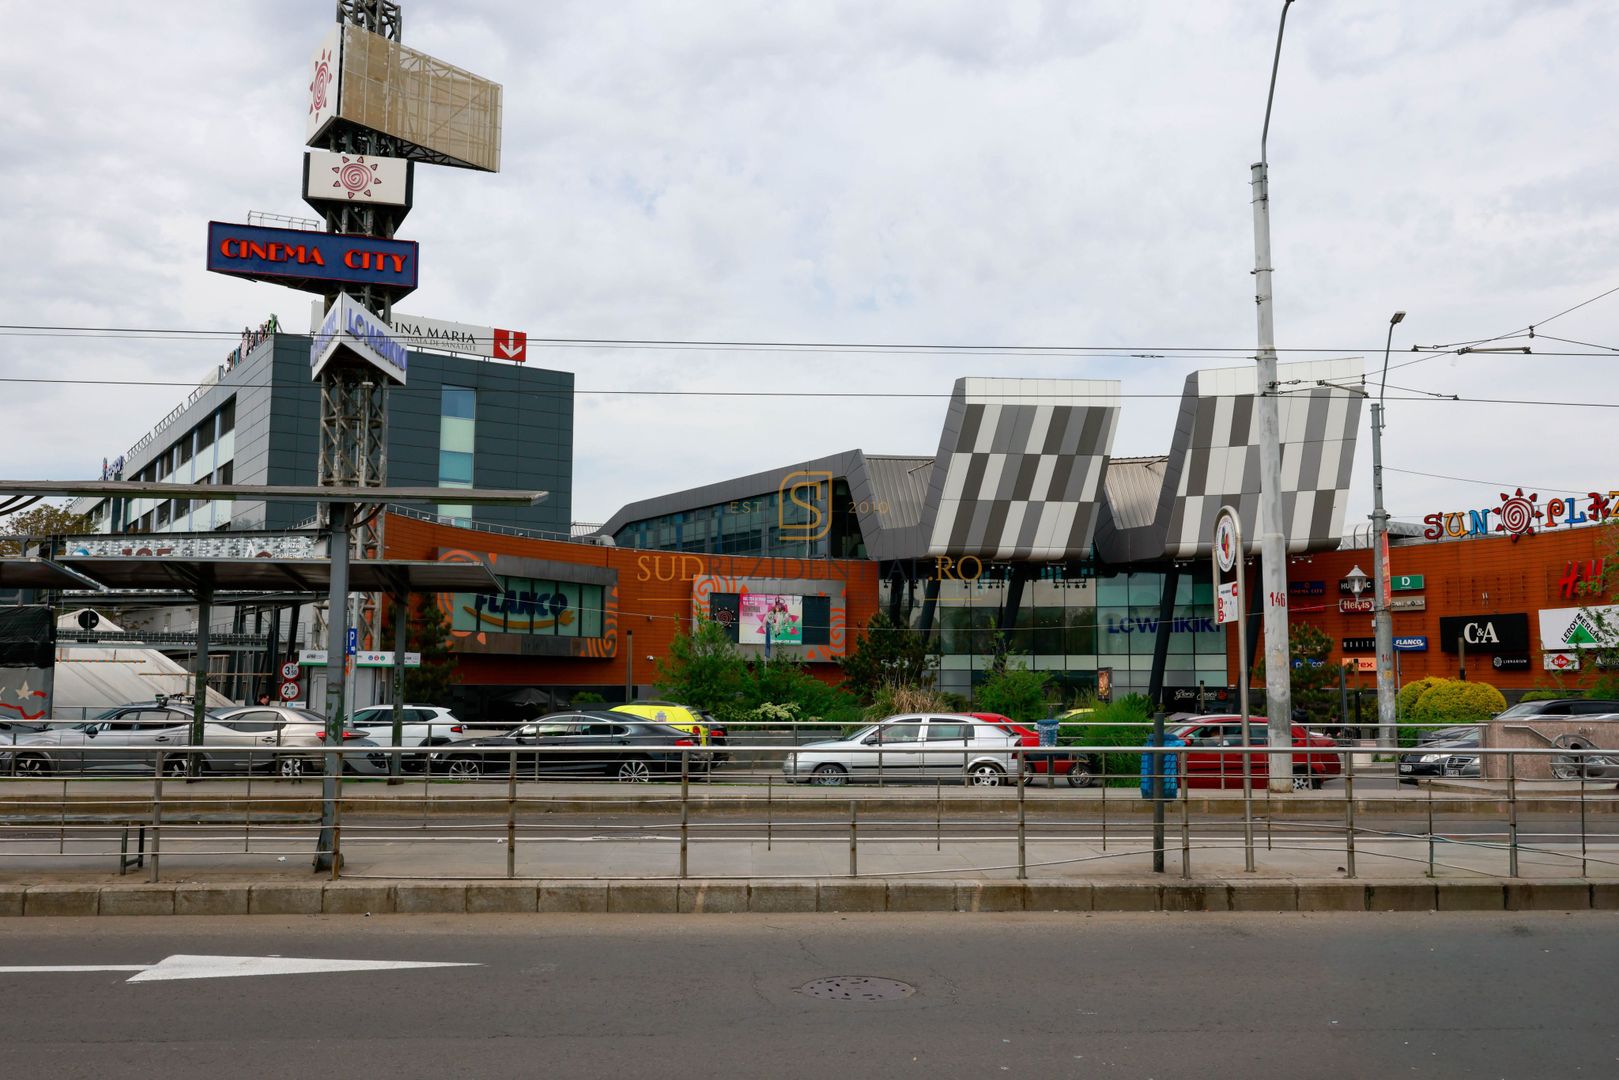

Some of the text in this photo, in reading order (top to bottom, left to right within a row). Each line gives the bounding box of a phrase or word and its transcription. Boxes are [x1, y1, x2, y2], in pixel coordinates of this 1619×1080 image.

[220, 238, 407, 273] CINEMA CITY
[426, 327, 476, 344] MARIA
[1423, 511, 1490, 540] SUN
[1401, 576, 1411, 586] D
[474, 590, 568, 617] FLANCO
[1270, 592, 1286, 607] 146
[1463, 621, 1500, 644] C&A
[1560, 620, 1579, 643] LEROY
